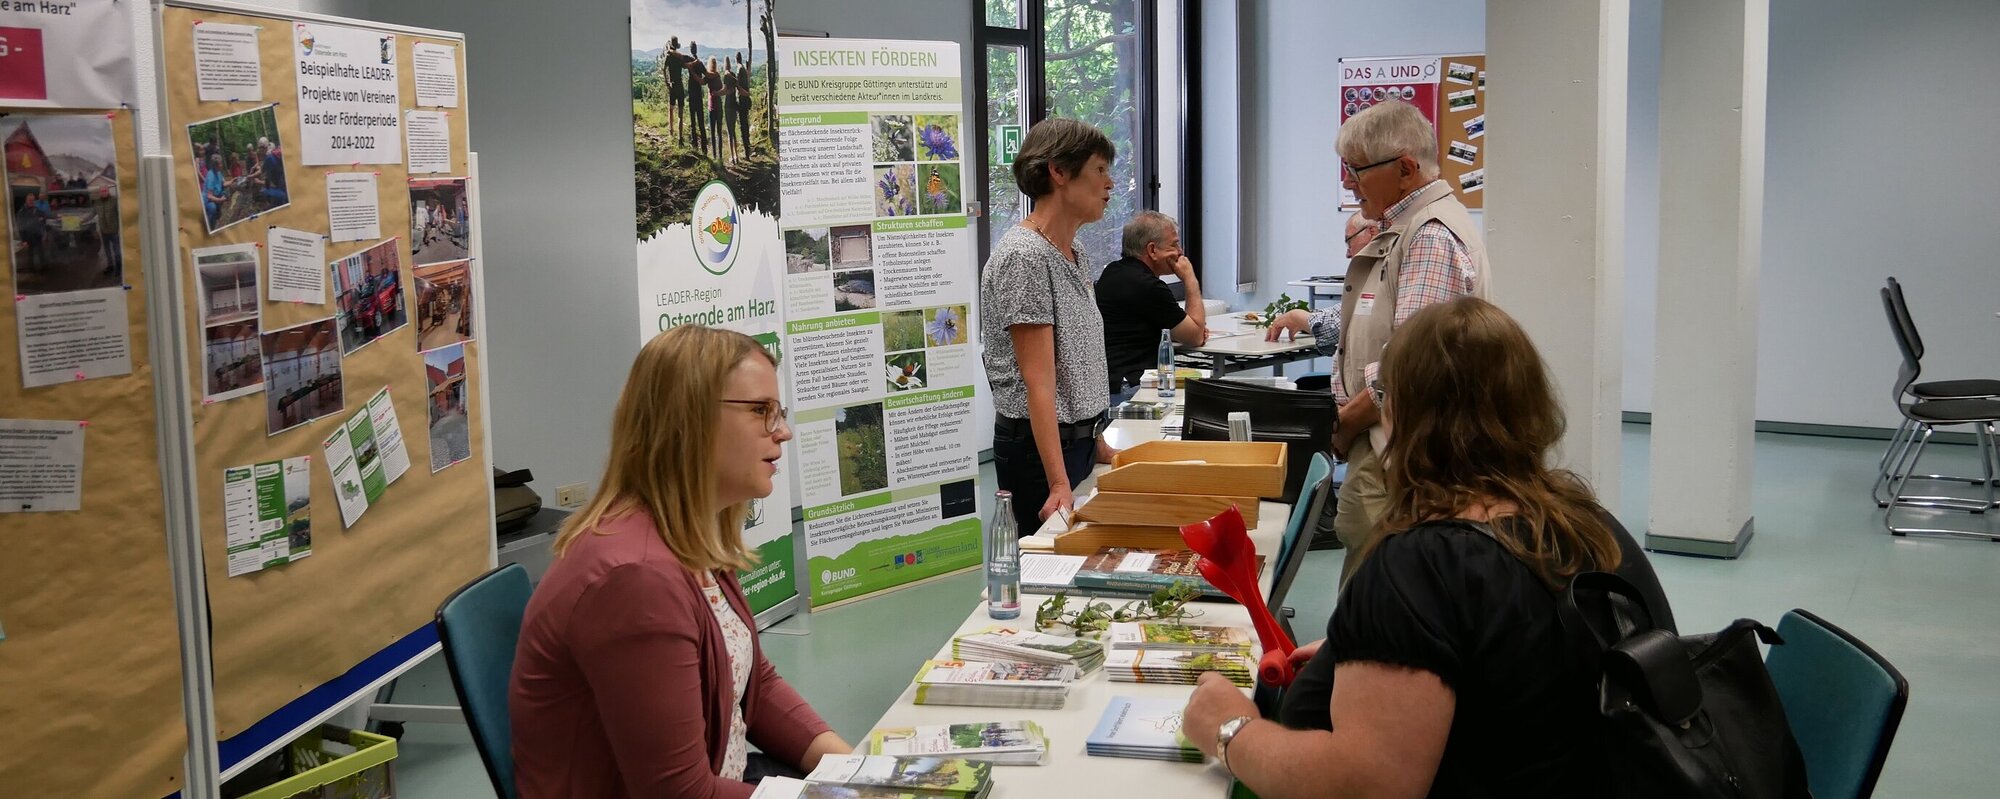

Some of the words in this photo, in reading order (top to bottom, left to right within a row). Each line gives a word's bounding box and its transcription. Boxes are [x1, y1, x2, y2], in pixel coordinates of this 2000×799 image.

[14, 2, 35, 12] am
[793, 51, 865, 66] INSEKTEN
[872, 47, 937, 67] FÖRDERN
[301, 61, 359, 79] Beispielhafte
[362, 66, 394, 81] LEADER-
[1345, 67, 1371, 79] DAS
[1376, 67, 1386, 78] A
[1391, 66, 1420, 78] UND
[784, 81, 797, 89] Die
[799, 81, 819, 89] BUND
[821, 80, 861, 90] Kreisgruppe
[863, 80, 896, 90] Göttingen
[898, 80, 933, 88] unterstützt
[302, 86, 340, 103] Projekte
[343, 91, 358, 102] von
[361, 89, 396, 104] Vereinen
[791, 93, 809, 102] berät
[812, 93, 855, 101] verschiedene
[912, 92, 943, 101] Landkreis.
[304, 114, 320, 124] aus
[323, 111, 337, 125] der
[340, 112, 397, 128] Förderperiode
[331, 136, 375, 149] 2014-2022
[877, 222, 913, 230] Strukturen
[915, 220, 943, 228] schaffen
[656, 287, 721, 307] LEADER-Region
[659, 305, 723, 332] Osterode
[728, 304, 744, 322] am
[749, 299, 775, 318] Harz
[792, 322, 823, 331] Nahrung
[826, 318, 856, 327] anbieten
[888, 394, 940, 407] Bewirtschaftung
[808, 503, 854, 518] Grundsätzlich
[916, 506, 940, 516] Minimieren
[809, 520, 835, 530] Reduzieren
[832, 568, 855, 581] BUND
